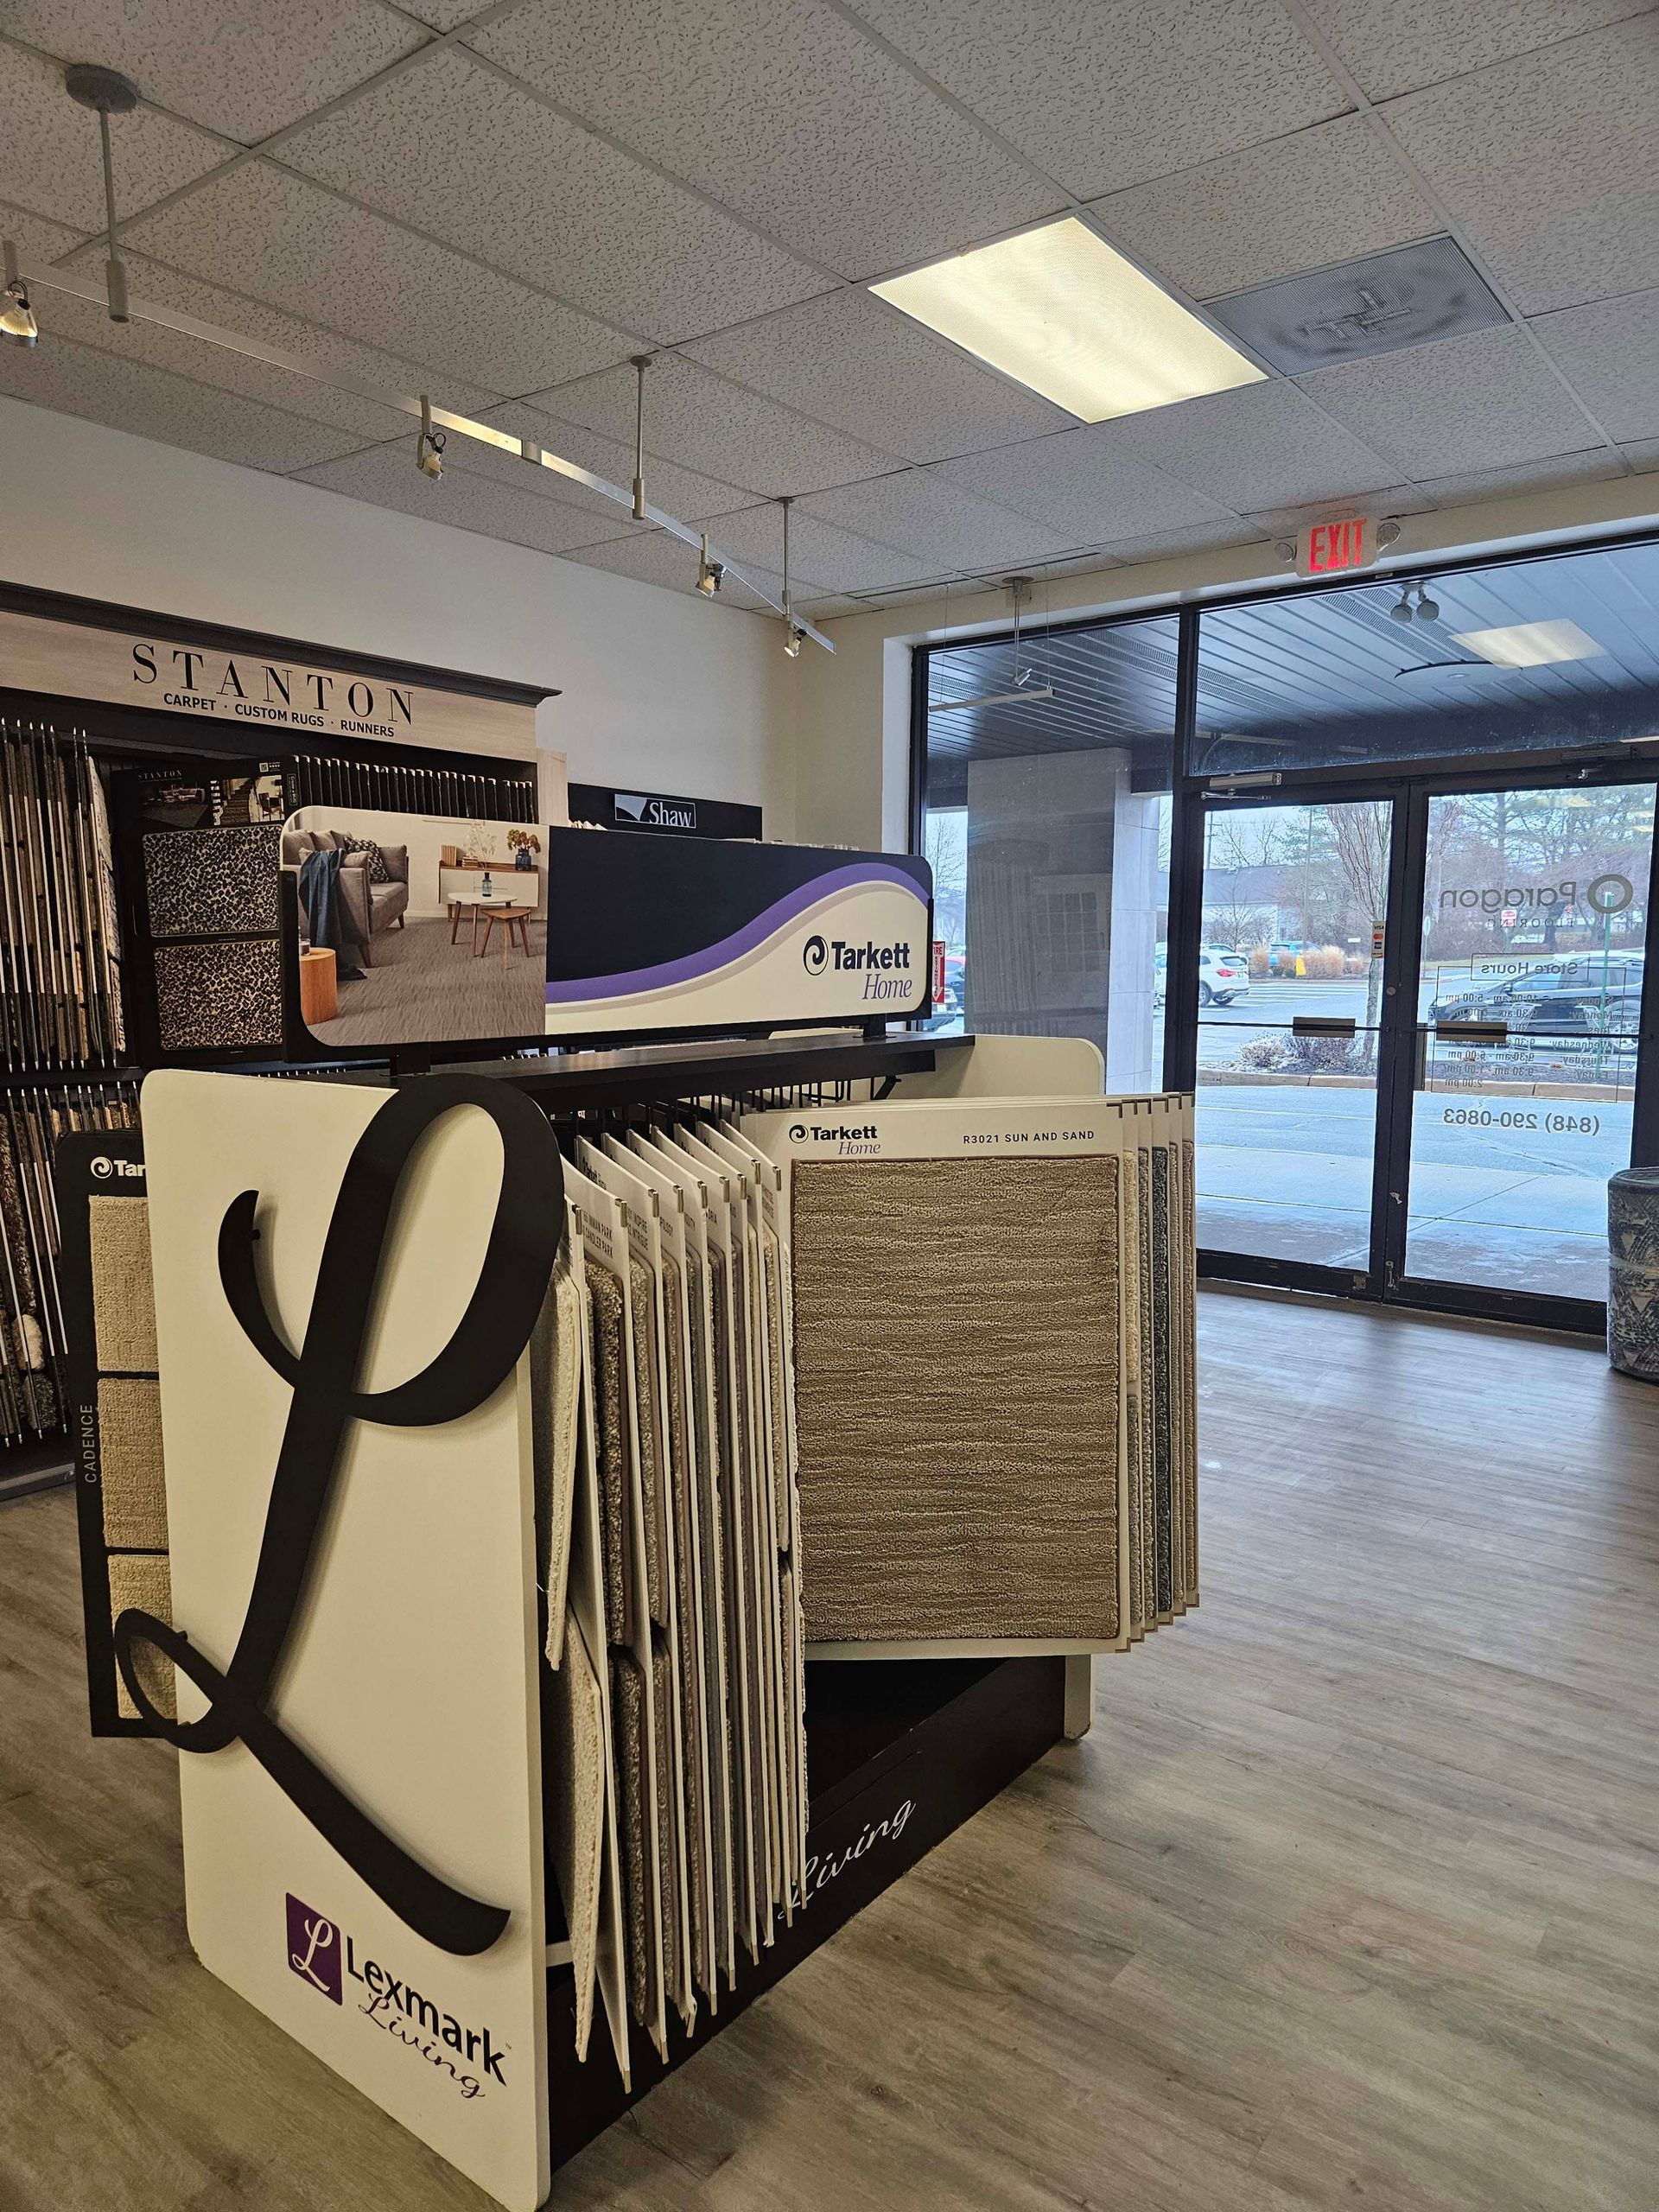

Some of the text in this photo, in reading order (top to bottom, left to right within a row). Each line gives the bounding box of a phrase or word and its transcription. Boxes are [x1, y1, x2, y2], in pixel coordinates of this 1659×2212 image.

[1309, 518, 1367, 573] EXIT
[132, 644, 414, 725] STANTON
[163, 693, 395, 737] CARPET CUSTOM RUGS RUNNERS
[138, 770, 182, 780] STANTON
[649, 801, 692, 827] Shaw
[831, 941, 910, 970] Tarkett
[934, 946, 943, 955] IRE
[861, 974, 912, 1000] Home
[810, 1126, 878, 1141] Tarkett
[963, 1130, 1095, 1144] R3021 SUN AND SAND
[837, 1141, 881, 1155] Home
[113, 1160, 146, 1176] Tar
[601, 1223, 613, 1242] PARK
[601, 1240, 613, 1259] PARK
[79, 1404, 97, 1484] CADENCE
[346, 1936, 507, 2087] Lexmark
[358, 1993, 486, 2098] Living
